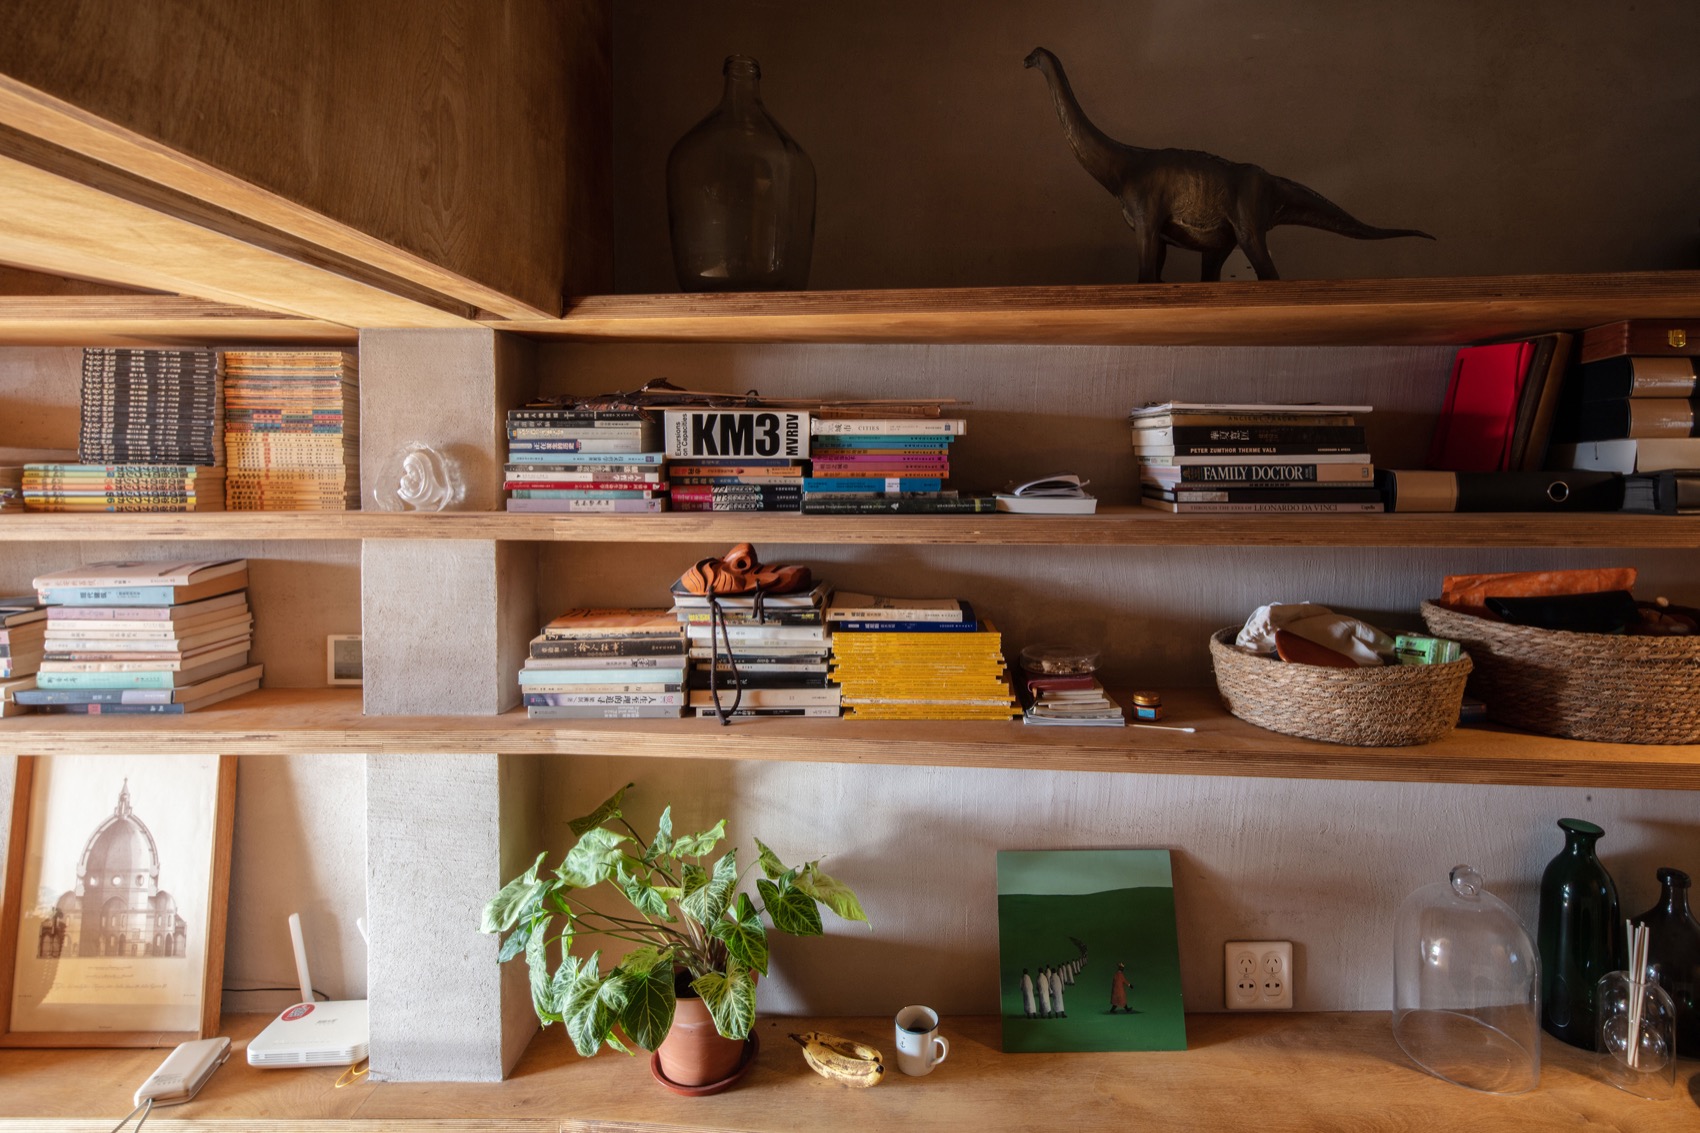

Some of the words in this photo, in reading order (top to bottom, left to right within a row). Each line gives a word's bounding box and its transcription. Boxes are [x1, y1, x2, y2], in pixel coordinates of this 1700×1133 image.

[692, 413, 780, 457] KM3
[786, 414, 799, 456] MVRDV
[1203, 466, 1248, 480] FAMILY
[1251, 466, 1303, 480] DOCTOR
[597, 695, 657, 704] 人生至理的追寻
